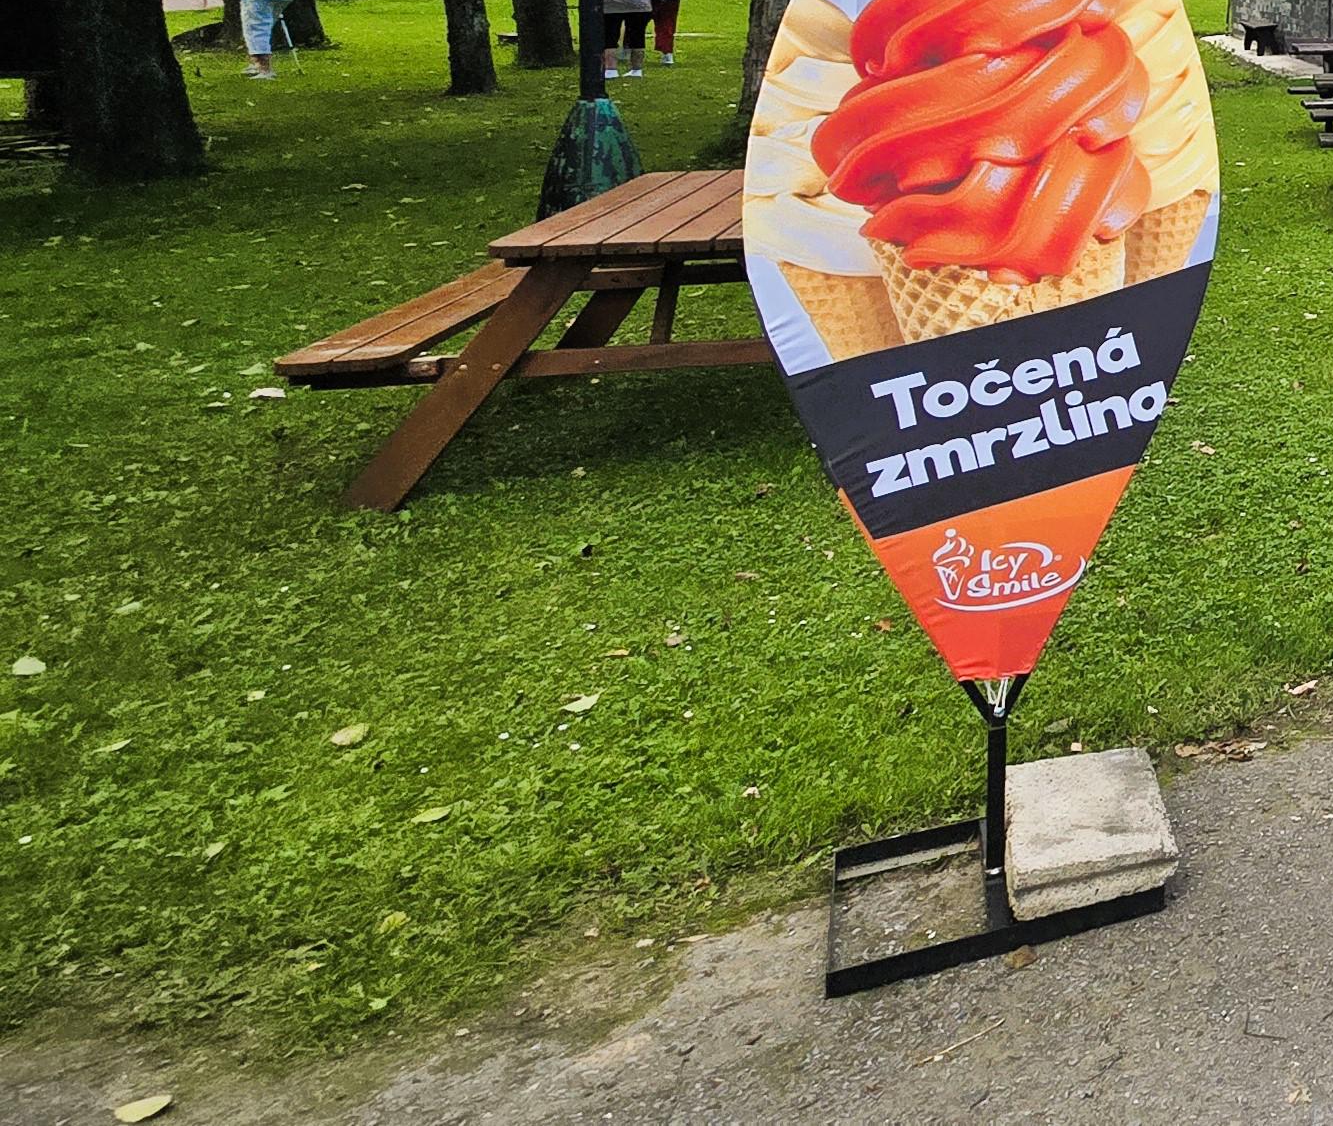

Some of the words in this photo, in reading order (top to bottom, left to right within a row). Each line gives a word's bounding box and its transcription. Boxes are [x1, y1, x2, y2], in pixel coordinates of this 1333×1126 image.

[870, 327, 1141, 430] Točená
[866, 380, 1167, 498] zmrzlina
[966, 571, 1062, 598] Smile
[980, 549, 1029, 578] Icy
